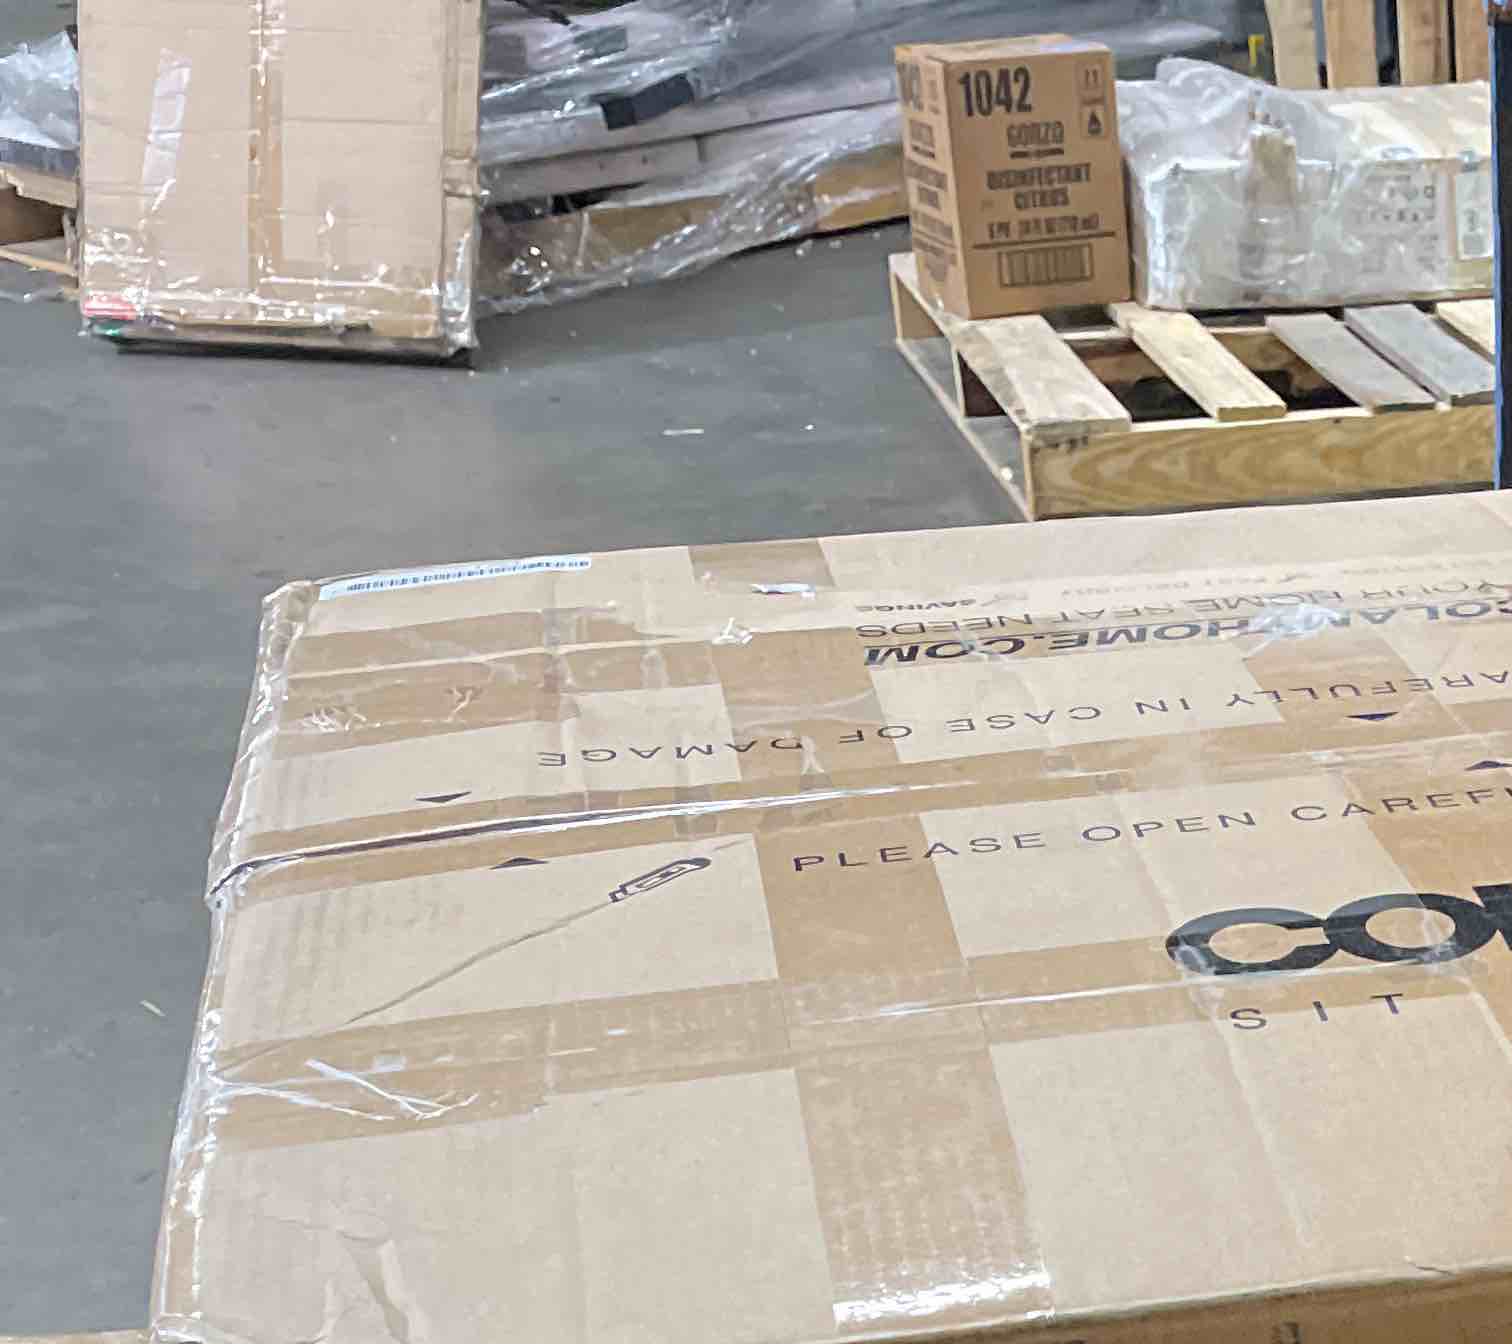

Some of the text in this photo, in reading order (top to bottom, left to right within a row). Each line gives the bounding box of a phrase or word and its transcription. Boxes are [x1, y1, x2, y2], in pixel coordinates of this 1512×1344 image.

[959, 67, 1032, 117] 1042
[857, 613, 1030, 638] NEEDS
[946, 705, 1102, 732] CASE
[1135, 697, 1191, 715] IN
[837, 725, 912, 745] OF
[537, 737, 804, 768] DAMAGE
[793, 832, 1046, 872] PLEASE
[1082, 812, 1257, 844] OPEN
[1229, 992, 1405, 1031] SIT
